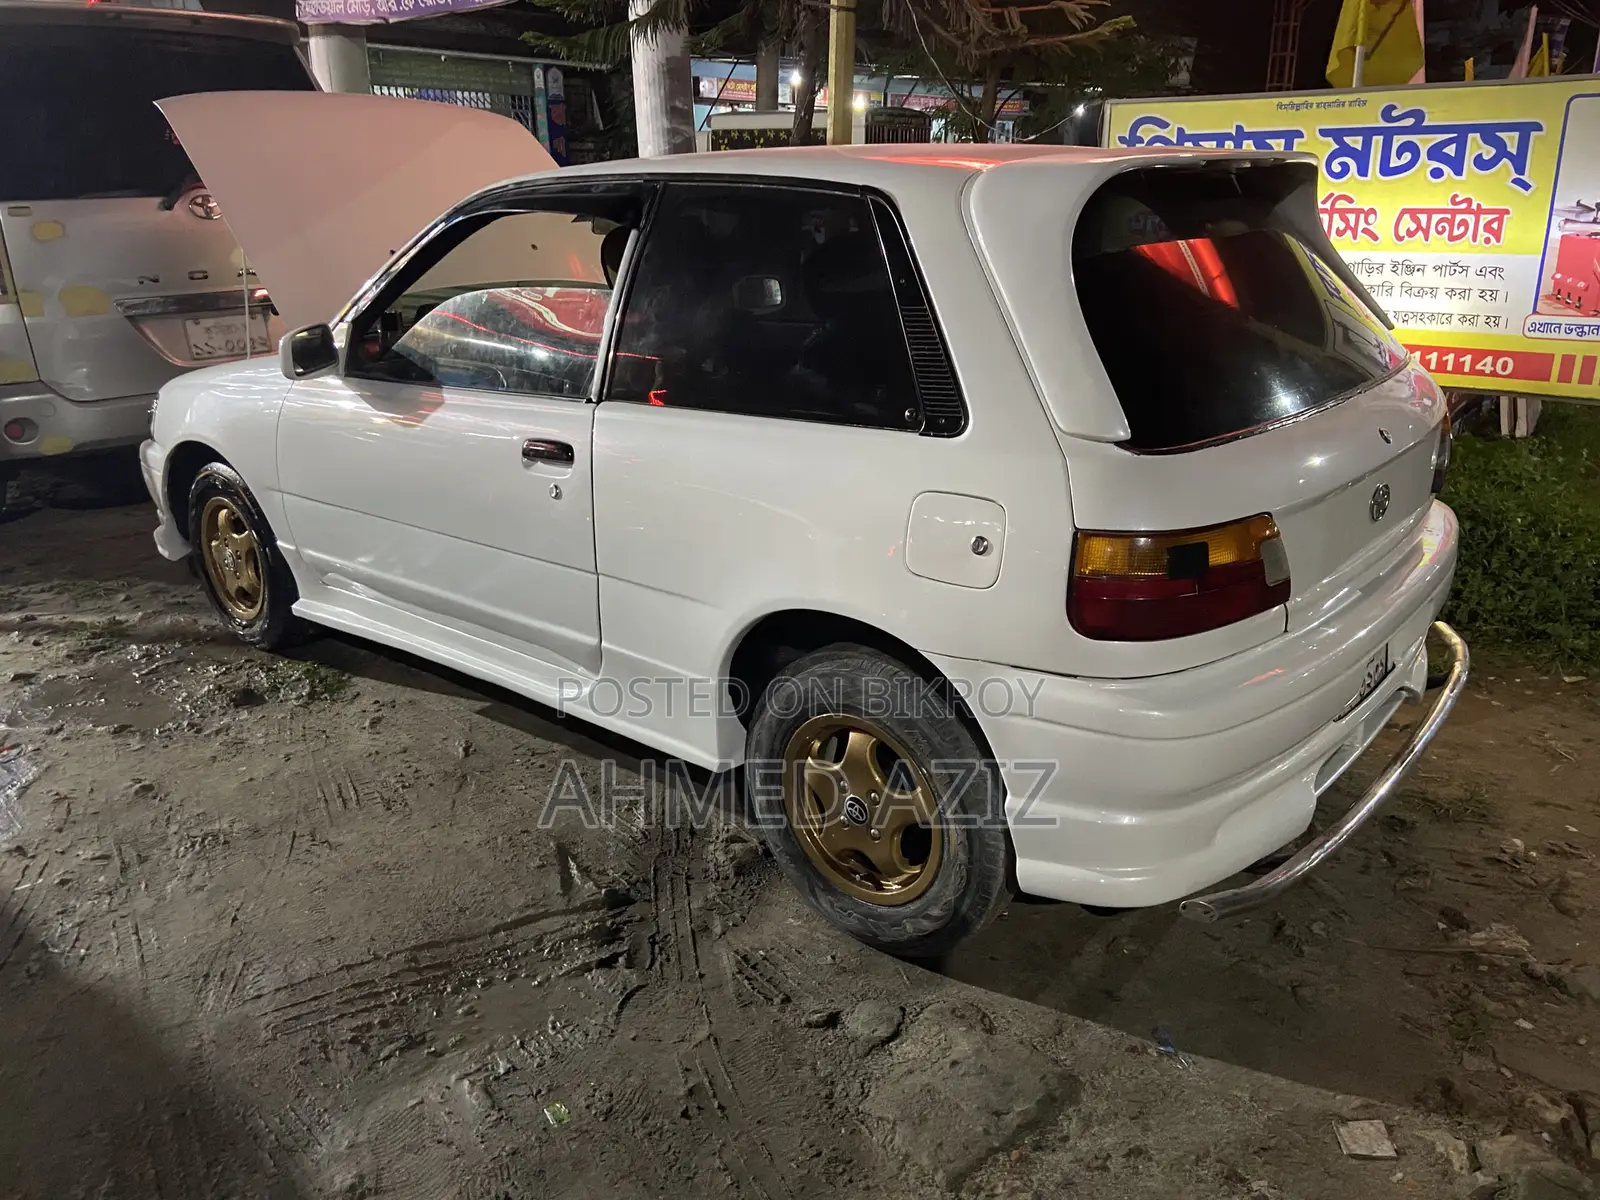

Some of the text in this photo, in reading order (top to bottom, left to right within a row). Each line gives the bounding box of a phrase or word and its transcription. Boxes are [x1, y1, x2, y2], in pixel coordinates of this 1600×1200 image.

[1318, 103, 1544, 191] মটরস্
[1393, 193, 1511, 245] সেন্টার
[1390, 259, 1428, 276] ইঞ্জিন
[1433, 260, 1471, 278] পার্টস
[1475, 265, 1505, 281] এবং
[1363, 280, 1395, 298] কারি
[1400, 281, 1440, 299] বিক্রয়
[1444, 286, 1473, 302] করা
[1392, 310, 1455, 326] যত্নসহকারে
[1457, 312, 1481, 327] করা
[1527, 321, 1563, 334] এখানে
[1411, 350, 1515, 375] 111140
